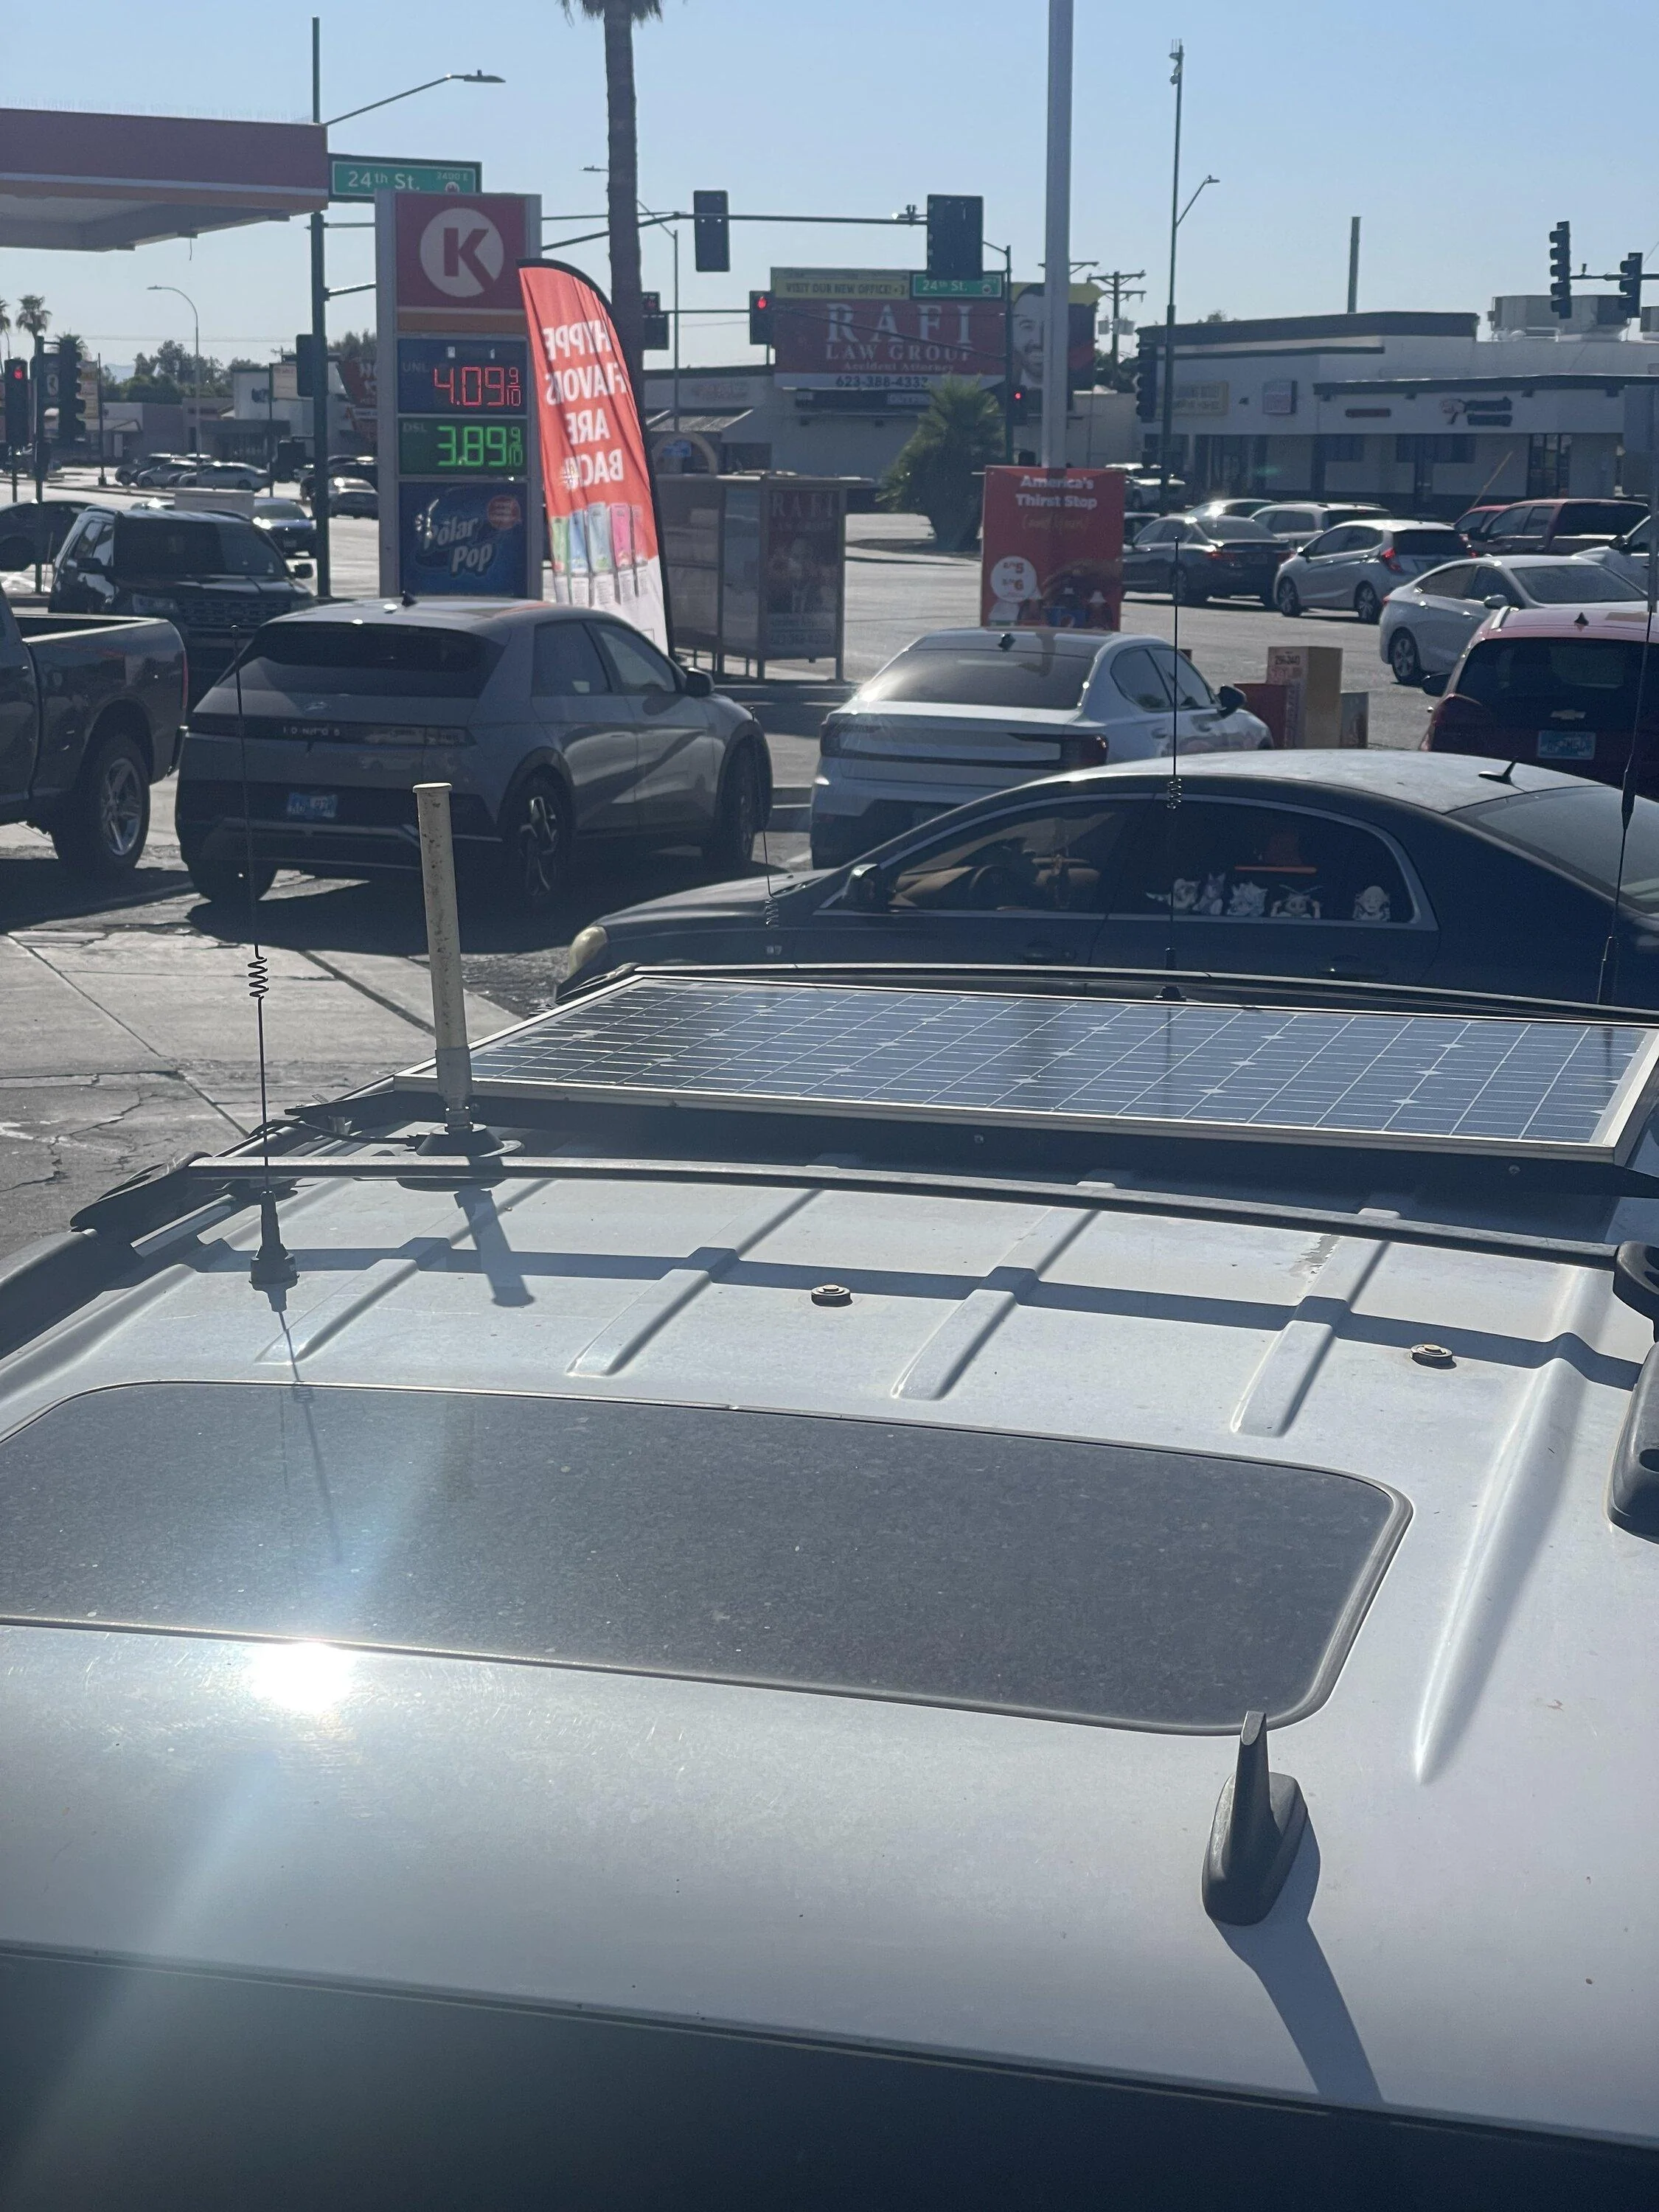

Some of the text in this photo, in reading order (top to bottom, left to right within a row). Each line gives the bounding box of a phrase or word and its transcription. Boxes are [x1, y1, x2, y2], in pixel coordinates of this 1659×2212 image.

[348, 170, 420, 190] 24th St.
[444, 227, 495, 292] K
[785, 282, 810, 293] VISIT
[813, 282, 832, 293] OUR
[835, 282, 855, 294] NEW
[922, 279, 948, 291] 24th
[951, 279, 967, 291] St.
[826, 303, 974, 344] RAFI
[826, 344, 973, 361] LAW GROUP
[844, 361, 896, 372] Accident
[434, 366, 506, 406] 4.09
[437, 426, 507, 467] 3.89
[1020, 475, 1094, 490] America's
[772, 492, 834, 518] RAFI
[1015, 493, 1097, 510] Thirst Stop
[423, 516, 479, 550] Polar
[451, 543, 493, 574] Pop
